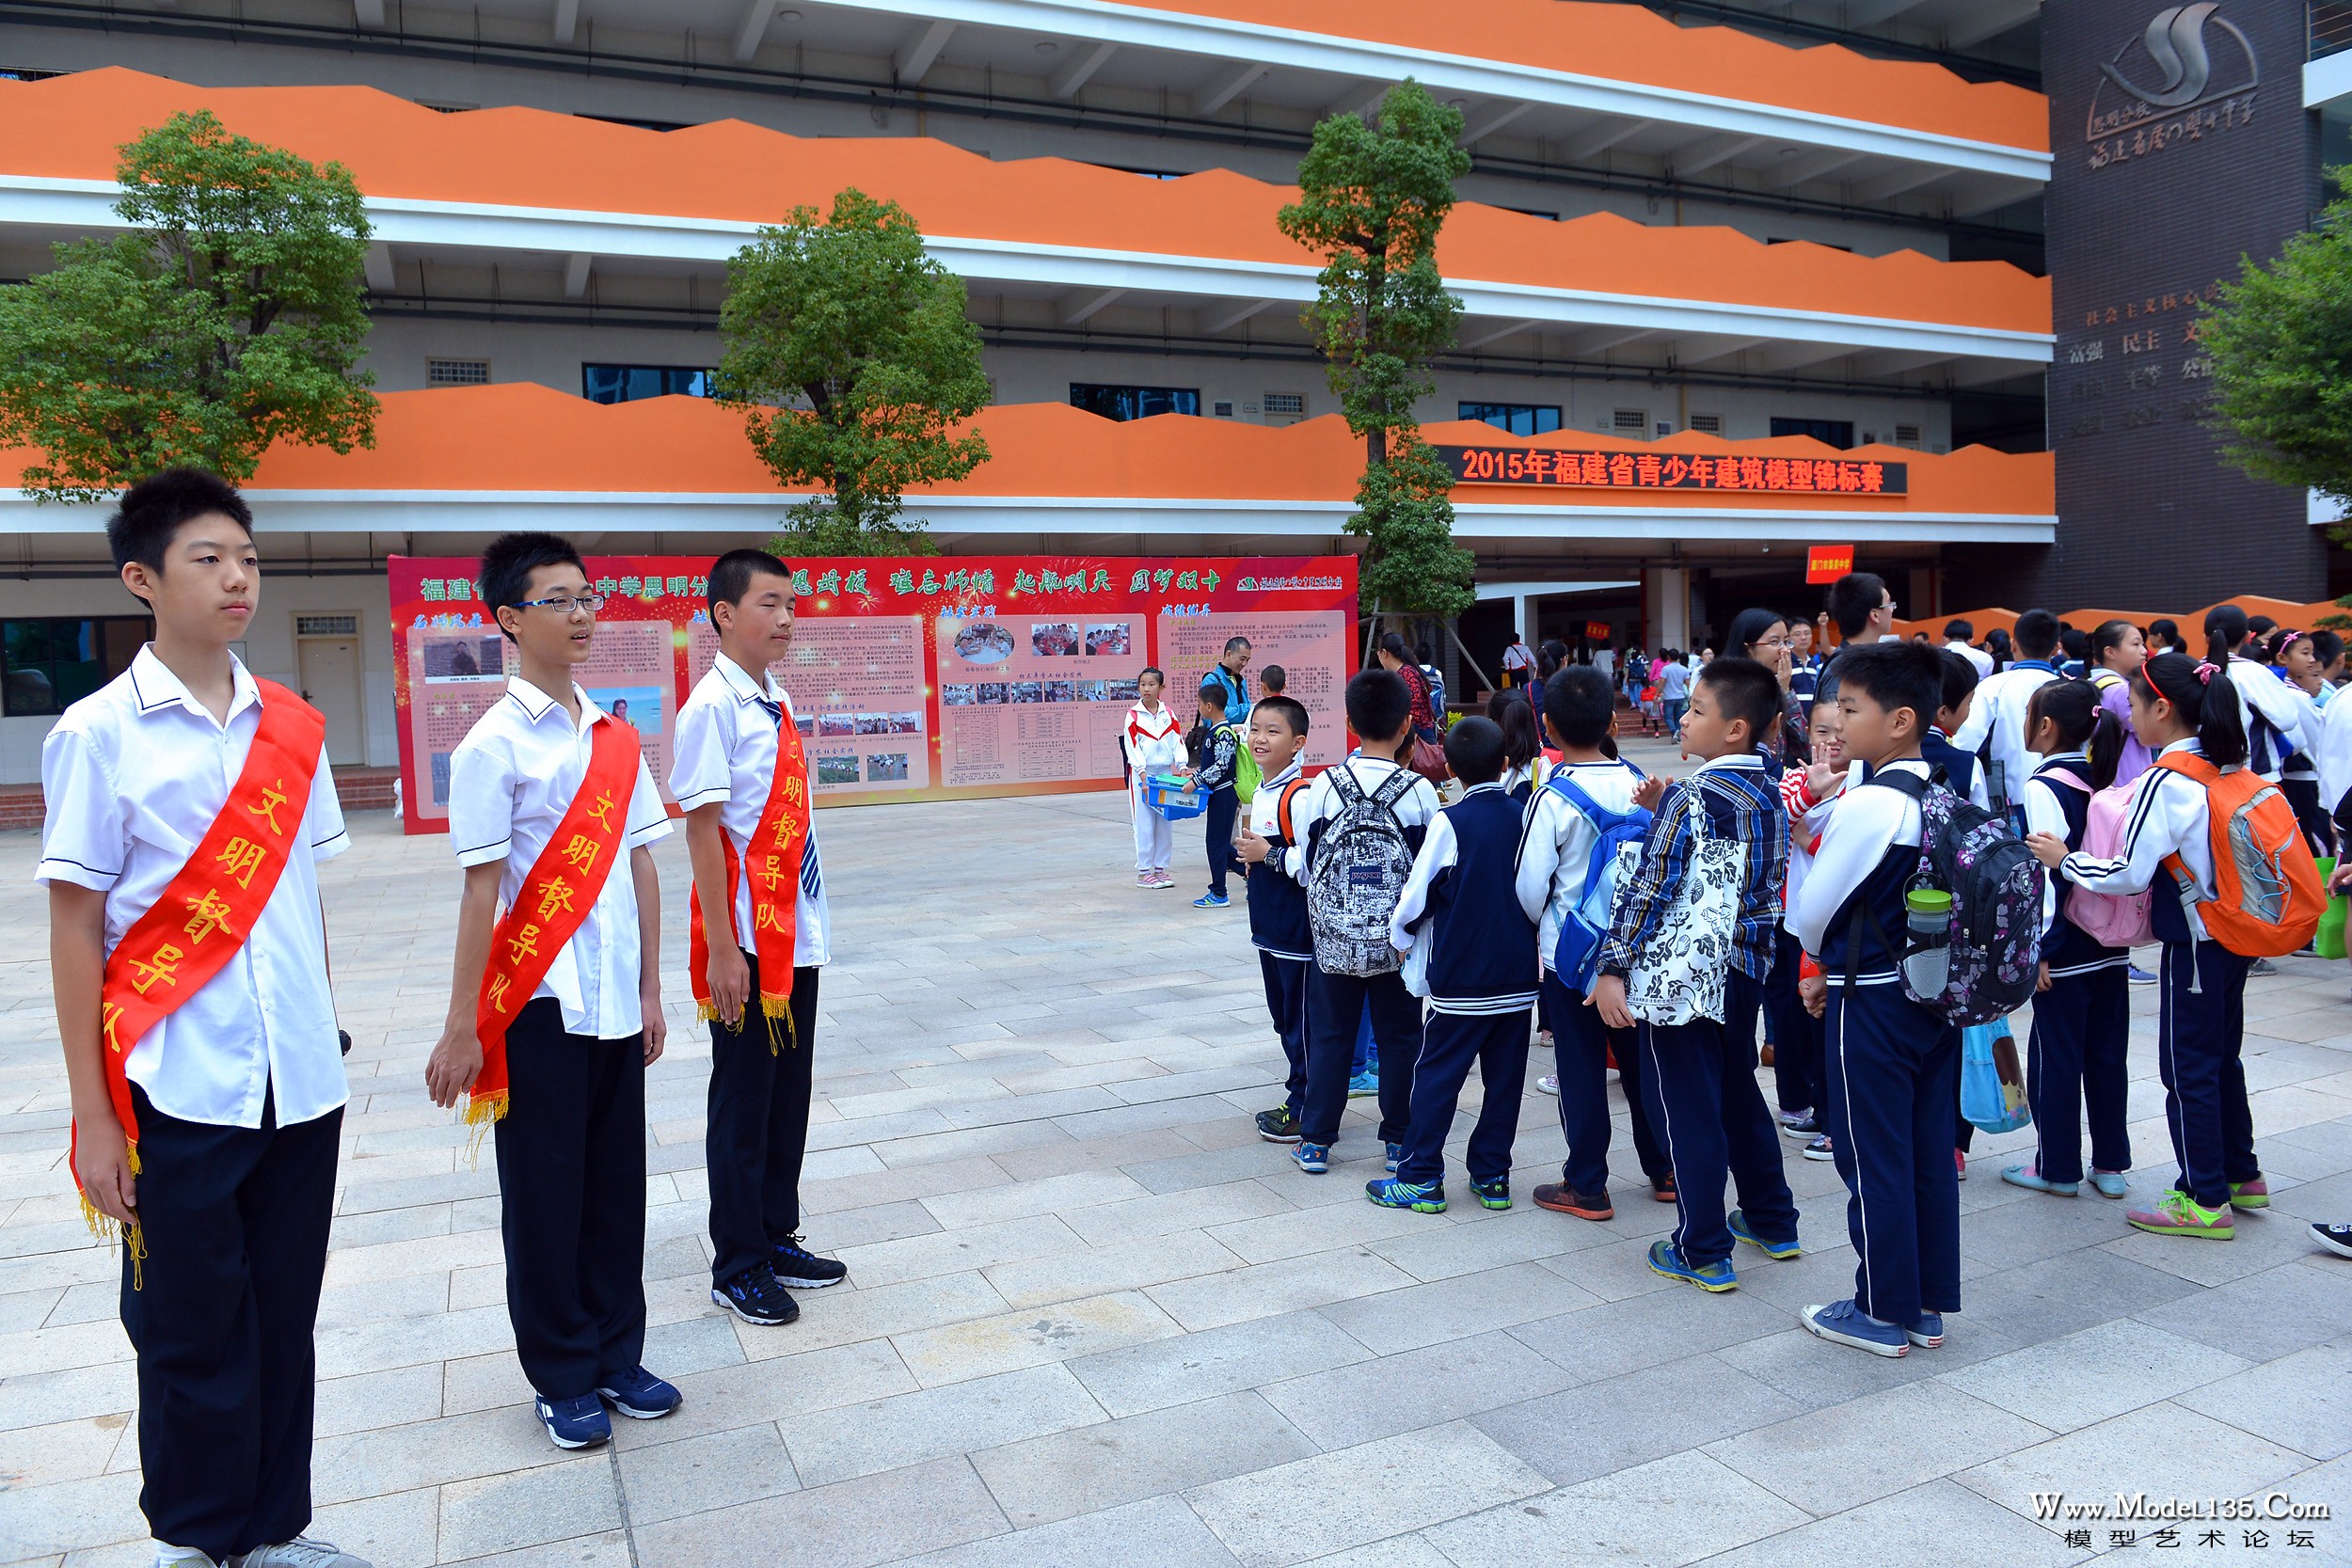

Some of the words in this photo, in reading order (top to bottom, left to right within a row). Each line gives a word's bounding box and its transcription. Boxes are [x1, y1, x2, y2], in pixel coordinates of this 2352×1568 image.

[2069, 341, 2104, 364] 富强
[2122, 330, 2161, 355] 民主
[1463, 448, 1883, 493] 2015年福建省青少年建筑模型锦标赛
[592, 575, 709, 600] 中学思明分
[889, 568, 995, 596] 难忘师情
[1012, 569, 1112, 594] 起航明天
[1129, 568, 1221, 594] 圆梦双十
[413, 611, 484, 629] 名师风采
[941, 605, 996, 619] 社会实践
[1161, 603, 1212, 617] 成绩优异
[755, 740, 805, 934] 文明督导队
[1351, 871, 1381, 880] JANSPORT
[487, 789, 616, 1014] 文明督导队
